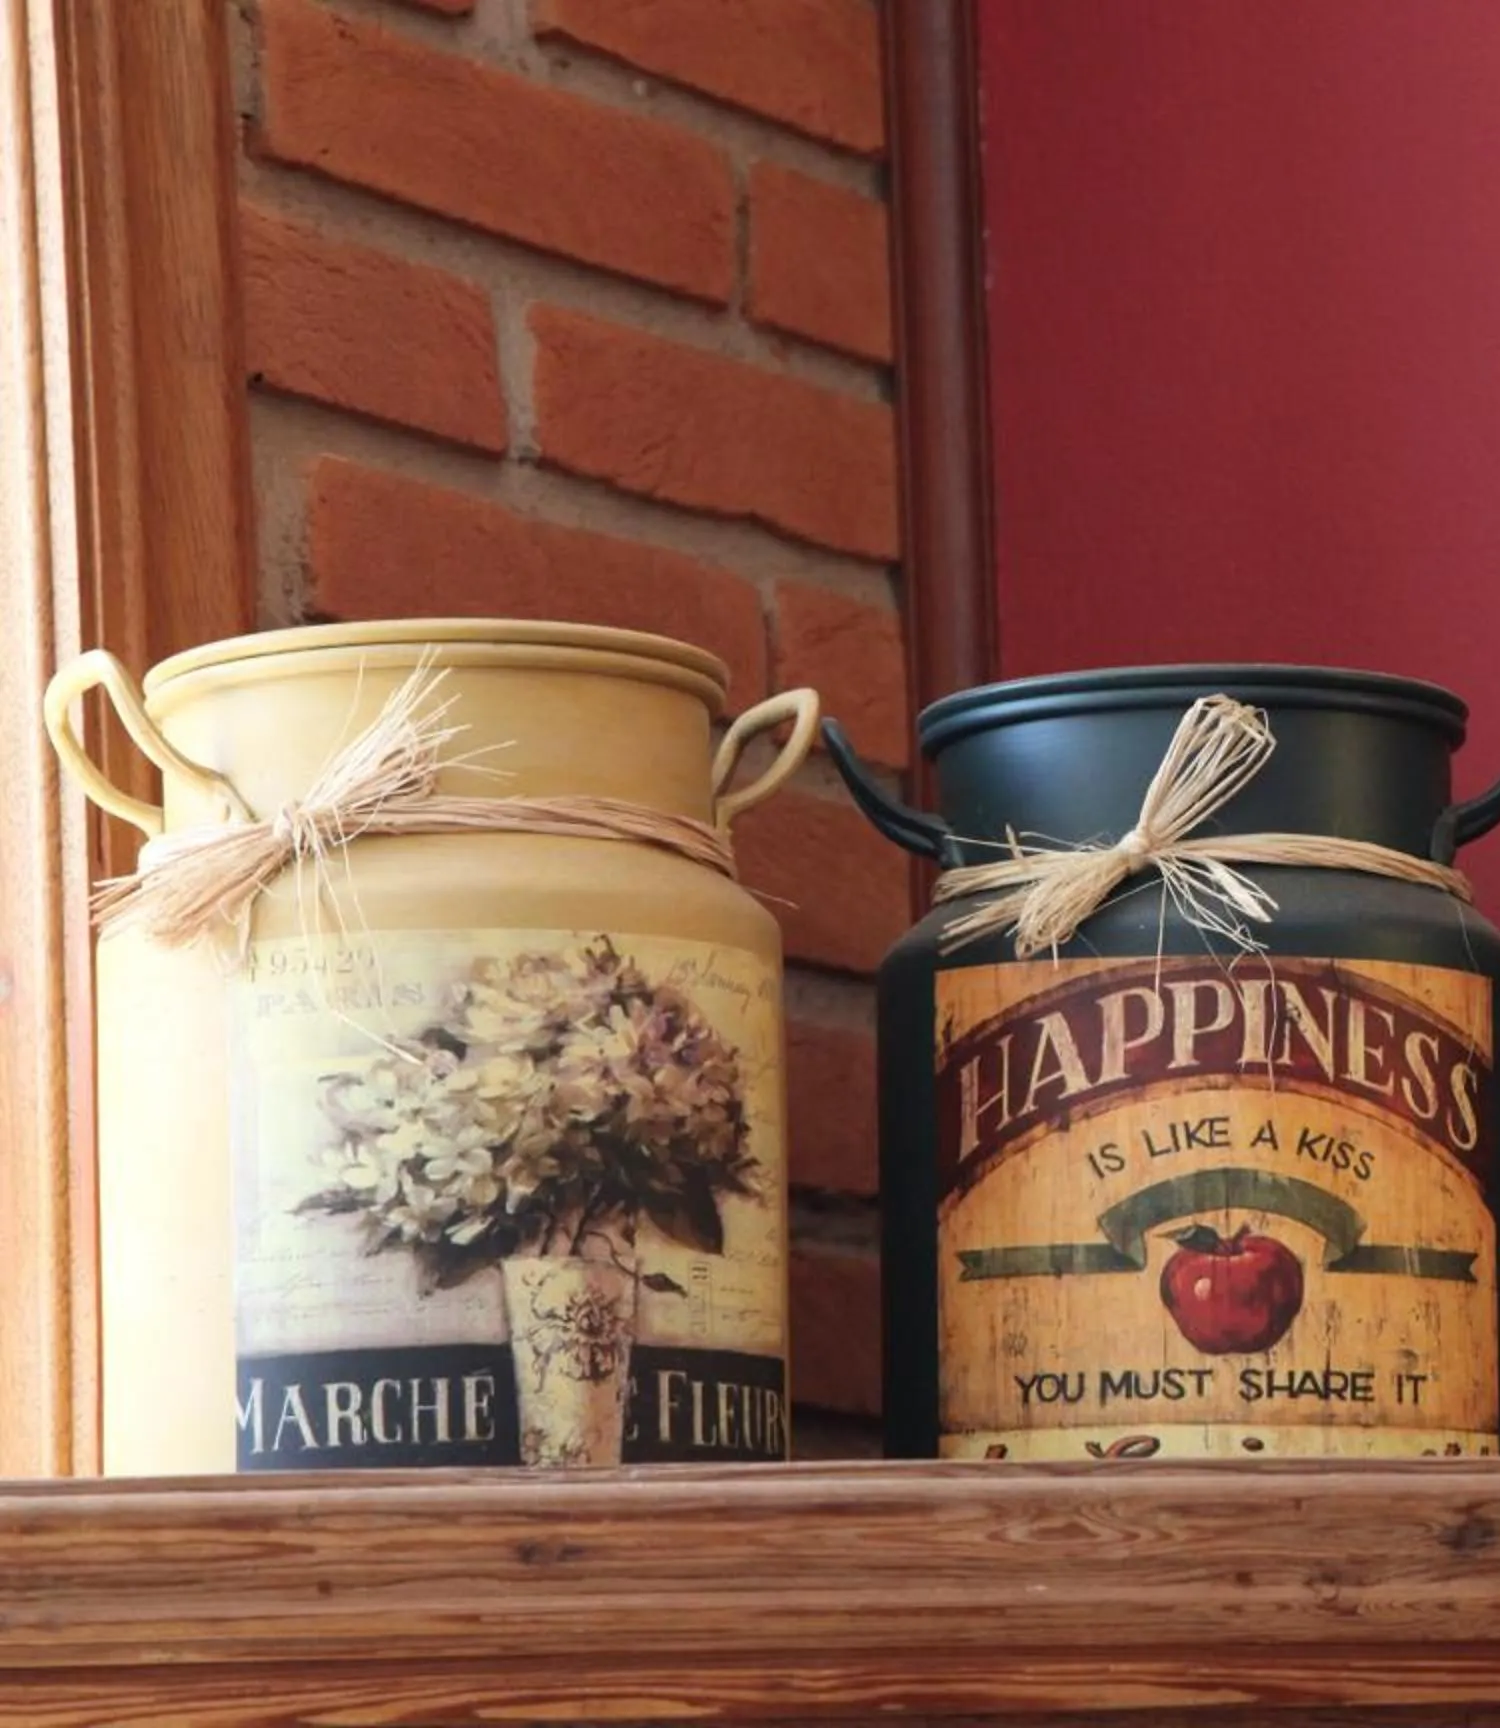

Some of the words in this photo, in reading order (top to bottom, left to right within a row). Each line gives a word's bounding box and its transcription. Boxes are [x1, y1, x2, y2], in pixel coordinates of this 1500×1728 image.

[956, 977, 1480, 1164] HAPPINESS
[1086, 1142, 1126, 1180] IS
[1140, 1115, 1231, 1158] LIKE
[1249, 1119, 1280, 1151] A
[1295, 1126, 1376, 1182] KISS
[1013, 1372, 1086, 1405] YOU
[1099, 1367, 1214, 1403] MUST
[1238, 1369, 1376, 1404] SHARE
[1395, 1373, 1428, 1406] IT
